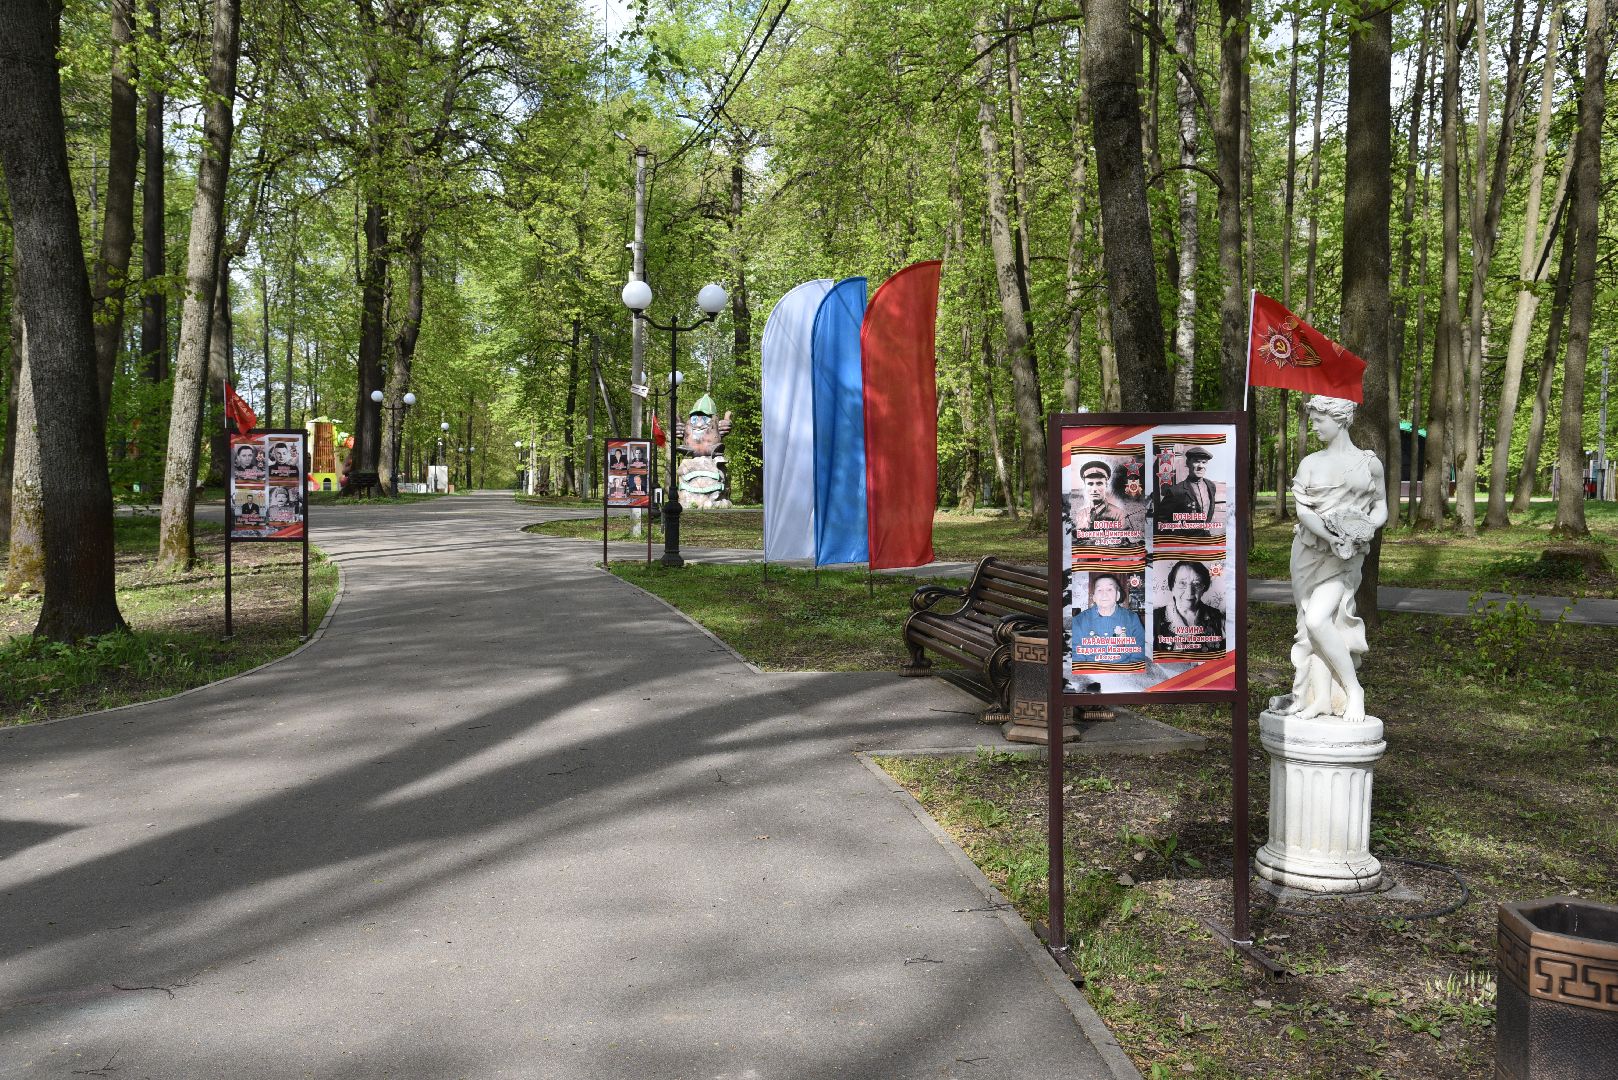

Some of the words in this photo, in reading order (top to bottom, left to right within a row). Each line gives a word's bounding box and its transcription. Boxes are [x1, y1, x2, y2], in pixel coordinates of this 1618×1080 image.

[1173, 512, 1207, 521] КОЗЫРЕВ
[1094, 520, 1123, 530] КОПАЕВ
[1077, 529, 1104, 538] Василий
[1175, 625, 1205, 634] КУЗИНА
[1082, 636, 1136, 646] КАРАВАШКИНА
[1158, 634, 1186, 643] Татьяна
[1187, 634, 1222, 643] Ивановна
[1076, 646, 1106, 655] Евдокия
[1107, 645, 1141, 654] Ивановна
